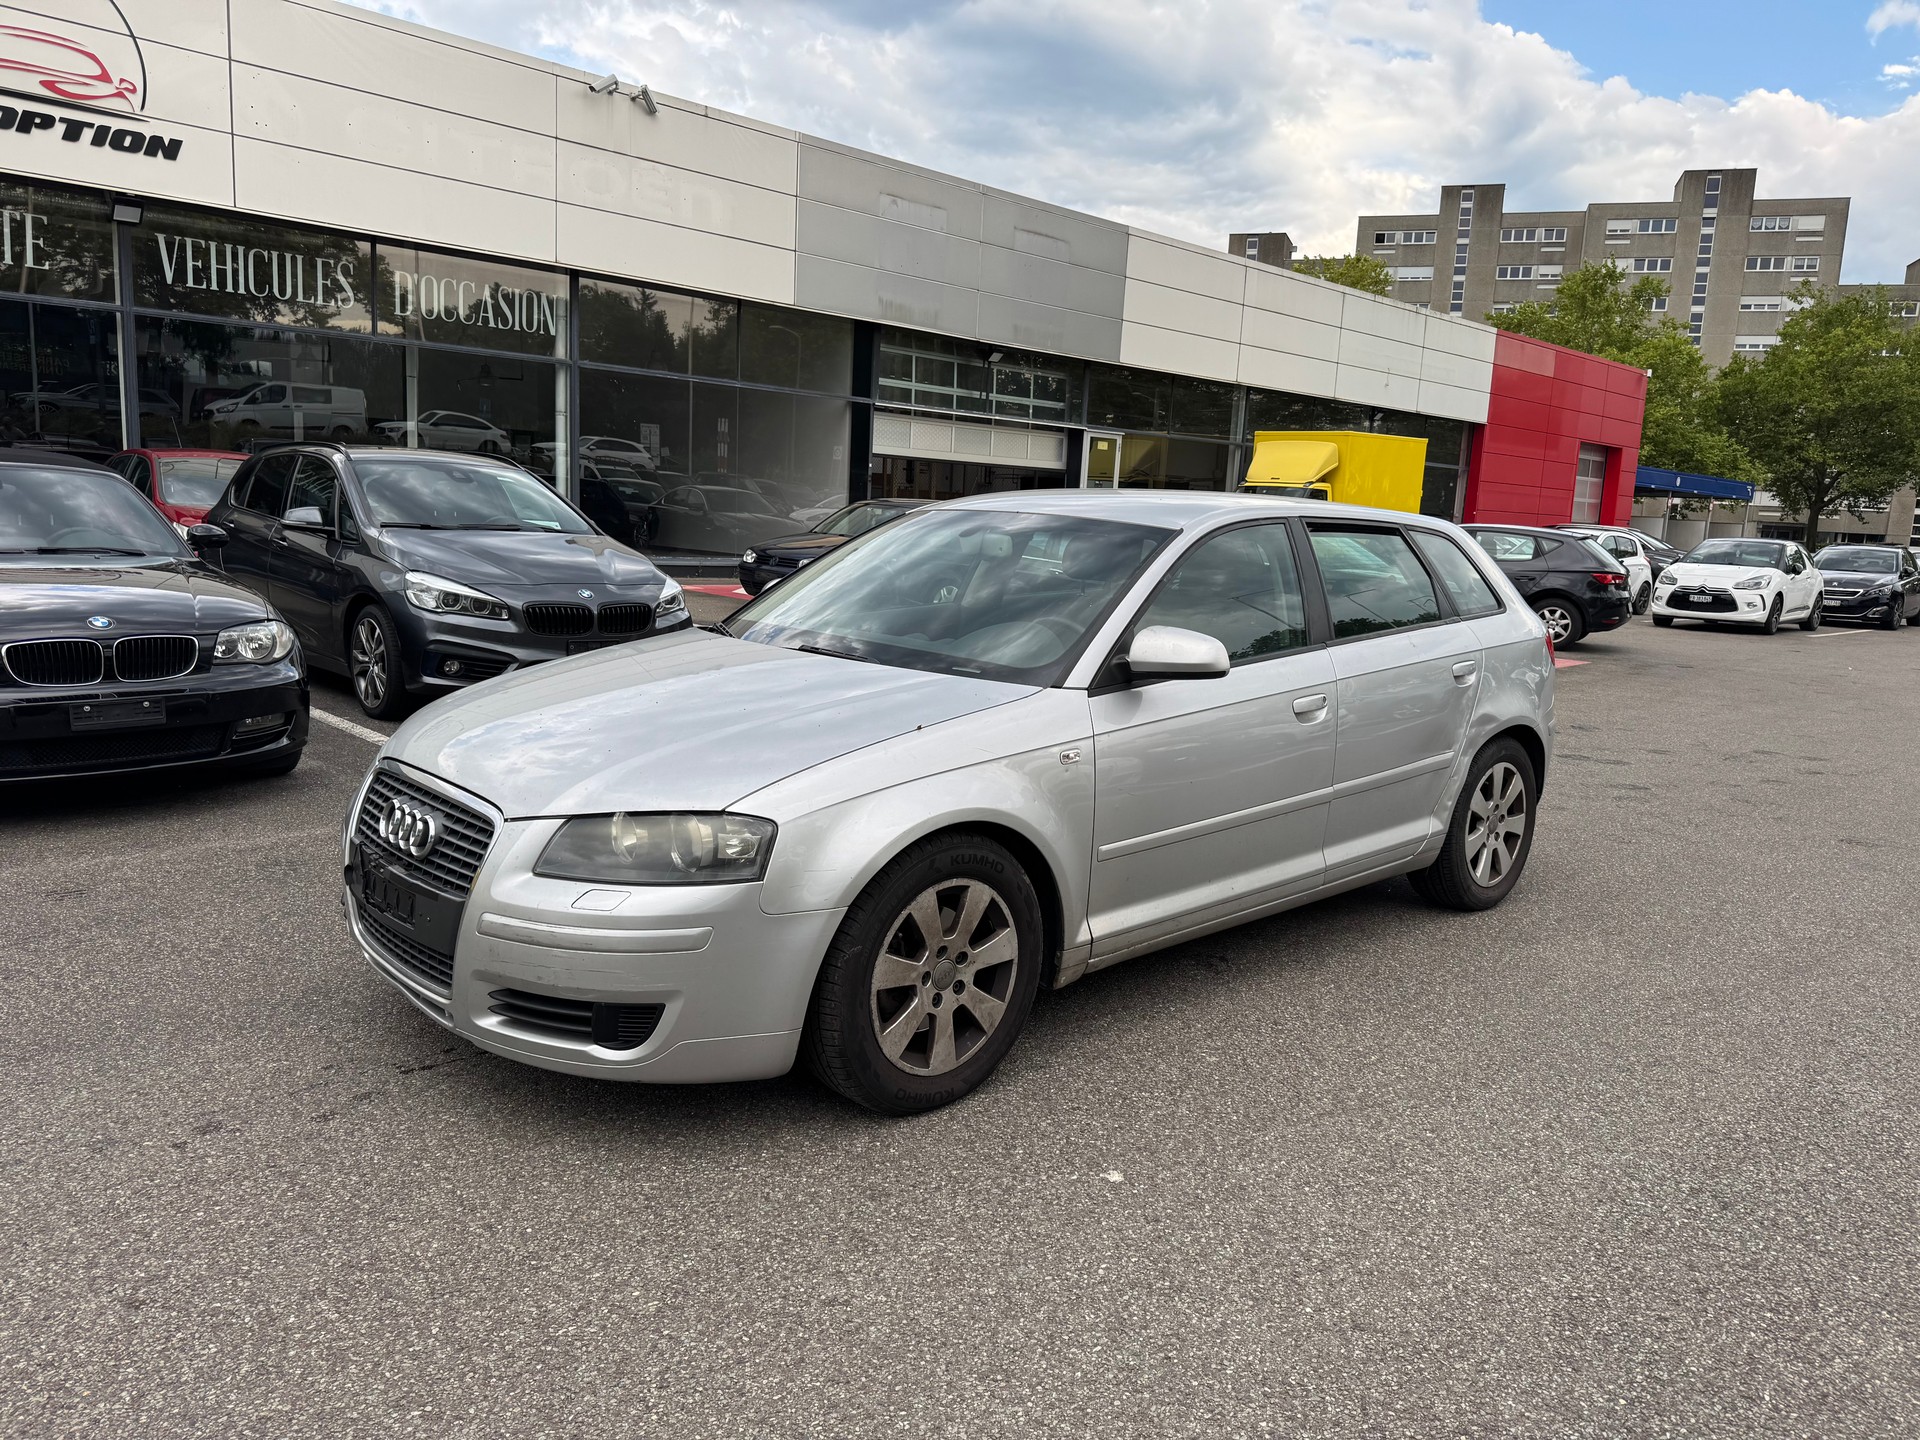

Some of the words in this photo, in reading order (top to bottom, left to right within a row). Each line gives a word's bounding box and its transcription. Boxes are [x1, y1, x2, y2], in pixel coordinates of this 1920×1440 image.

[154, 232, 355, 309] VEHICULES
[393, 270, 557, 336] D'OCCASION
[950, 852, 1005, 874] KUMHO
[894, 1087, 956, 1104] KUMHO
